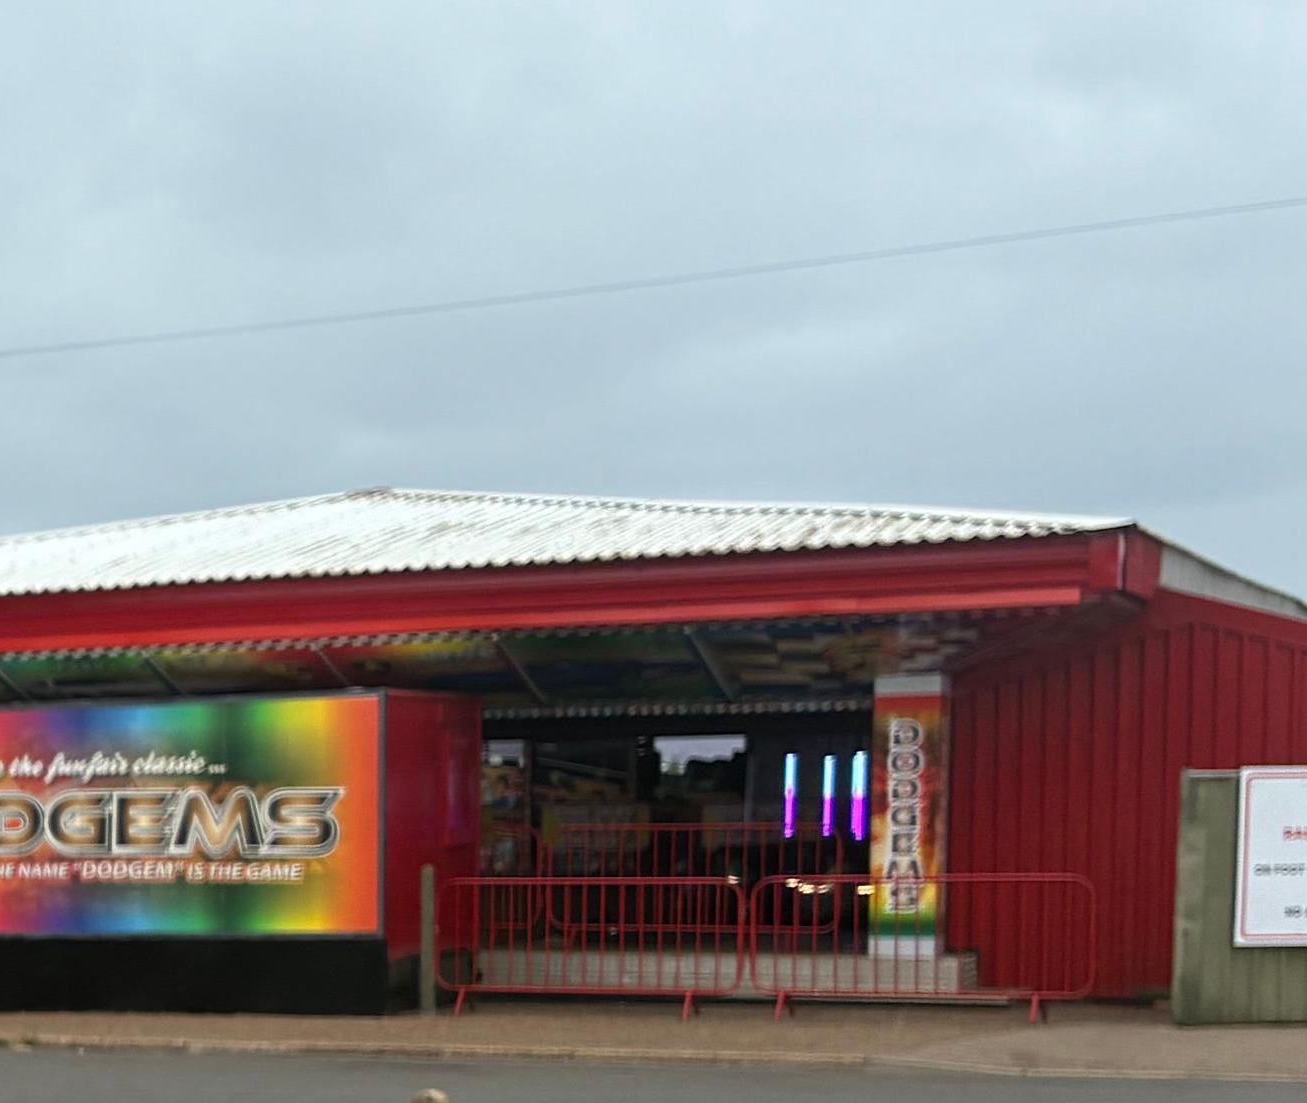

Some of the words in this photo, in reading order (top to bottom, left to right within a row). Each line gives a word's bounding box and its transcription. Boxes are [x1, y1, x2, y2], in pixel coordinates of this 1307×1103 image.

[8, 754, 43, 777] the
[44, 752, 128, 785] funfair
[18, 862, 69, 880] NAME
[187, 862, 204, 881] IS
[207, 862, 244, 881] THE
[246, 863, 305, 882] GAME
